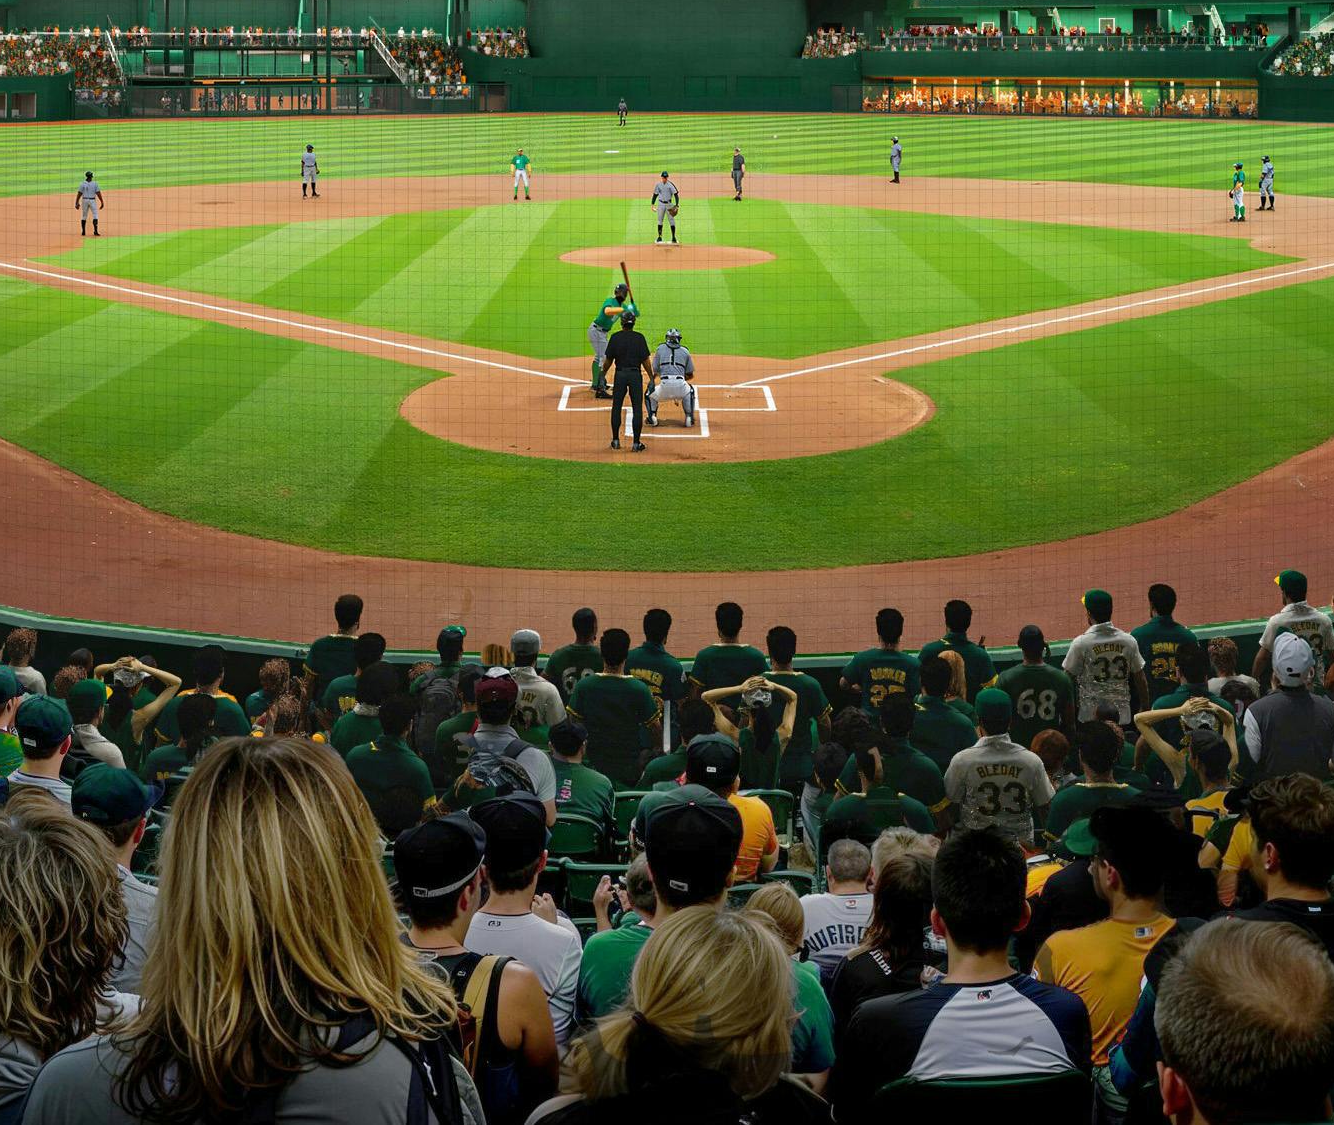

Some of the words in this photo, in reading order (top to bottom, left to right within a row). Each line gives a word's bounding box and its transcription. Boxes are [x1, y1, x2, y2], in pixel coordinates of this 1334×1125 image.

[1092, 656, 1129, 682] 33
[1017, 688, 1058, 721] 68
[976, 764, 1023, 780] BLEDAY
[977, 782, 1028, 816] 33
